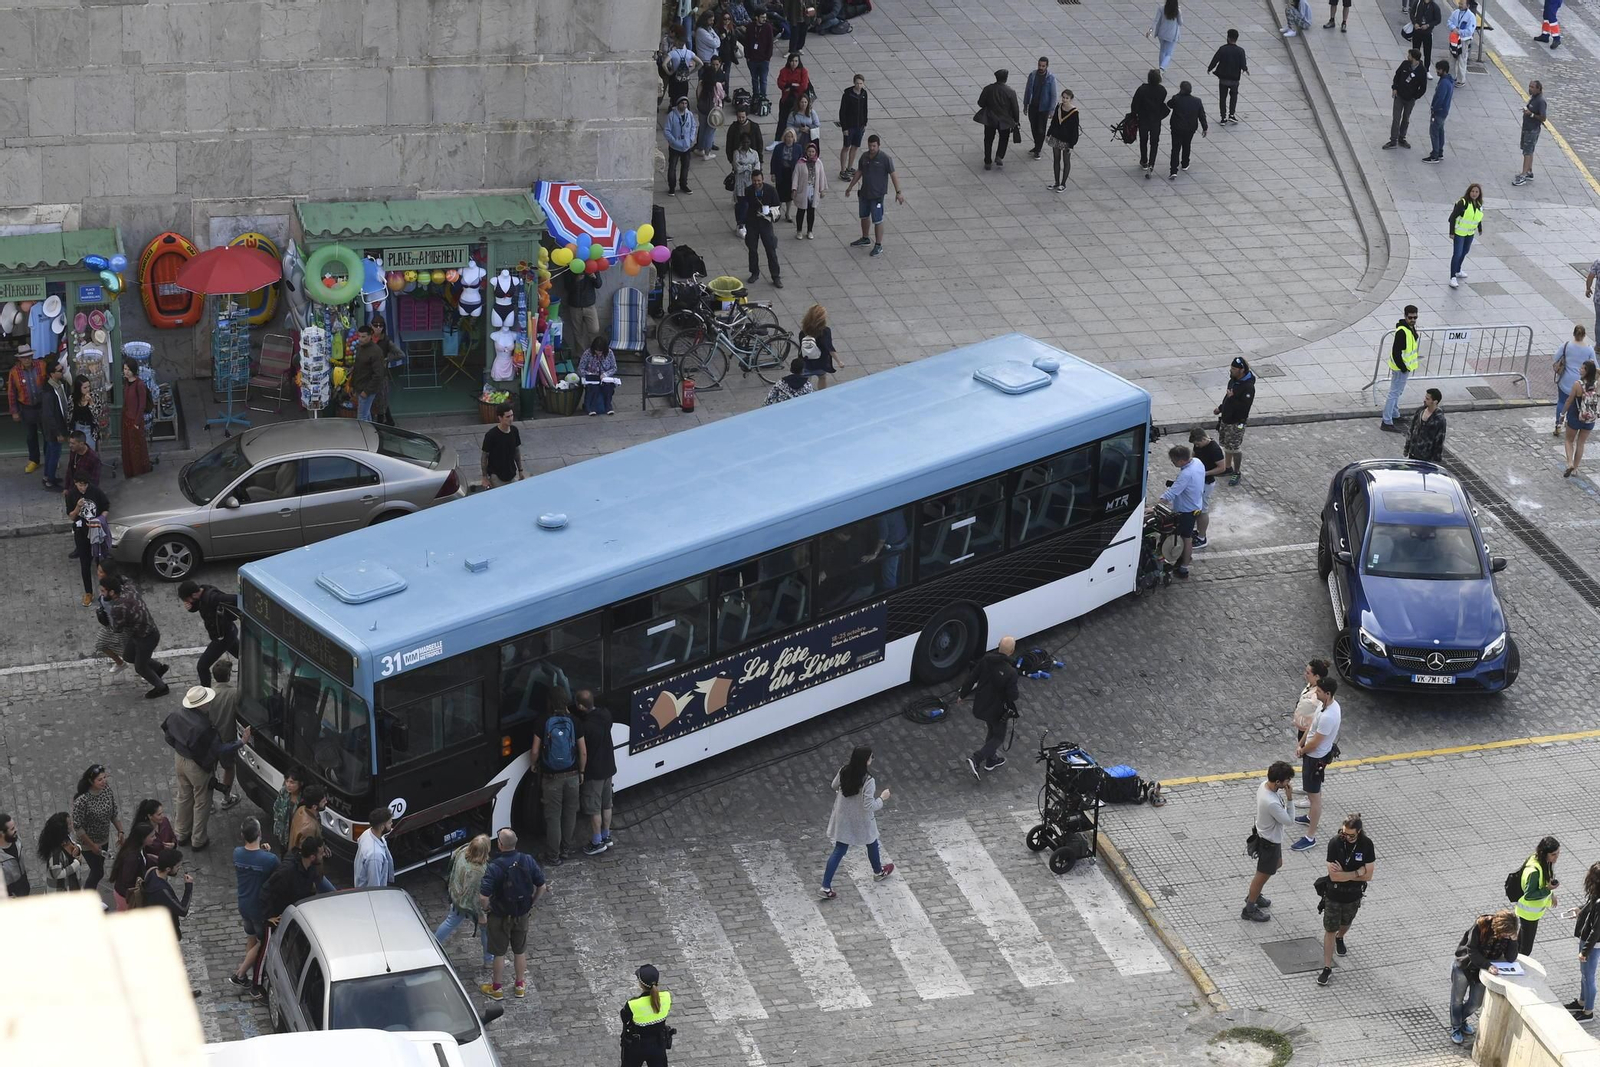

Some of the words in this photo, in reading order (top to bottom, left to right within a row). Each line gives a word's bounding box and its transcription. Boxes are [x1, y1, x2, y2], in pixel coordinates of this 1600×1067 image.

[1105, 494, 1129, 510] MTR
[255, 593, 270, 620] 31
[420, 641, 443, 653] MARSEILLE
[381, 651, 402, 676] 31
[405, 652, 418, 664] MM
[738, 656, 769, 684] La
[770, 646, 809, 680] fête
[768, 669, 796, 692] du
[798, 651, 852, 681] Livre
[391, 802, 403, 817] 70
